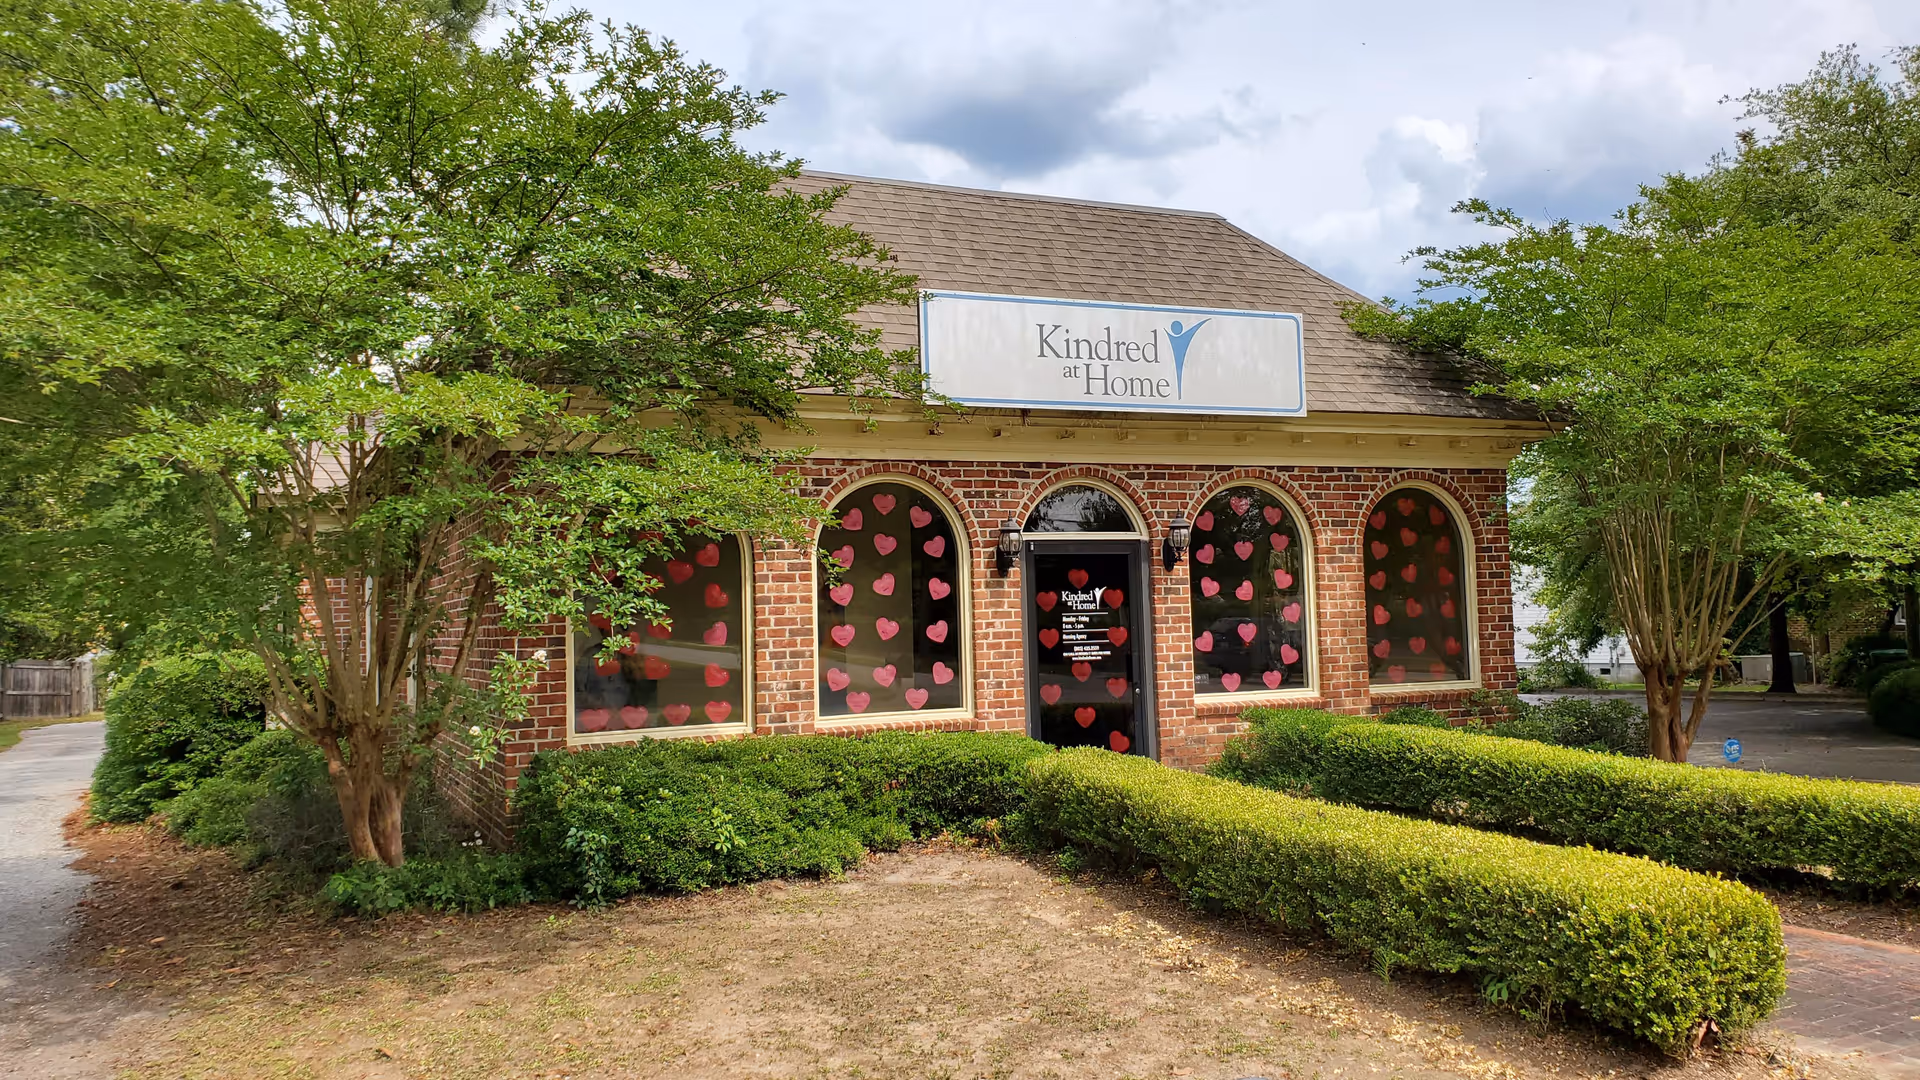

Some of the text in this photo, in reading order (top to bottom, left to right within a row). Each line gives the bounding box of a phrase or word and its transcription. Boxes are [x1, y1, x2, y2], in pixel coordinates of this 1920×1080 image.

[1035, 323, 1161, 364] Kindred
[1063, 363, 1171, 398] at Home
[1061, 590, 1093, 601] Kindred
[1072, 600, 1096, 610] Home
[1078, 615, 1090, 623] Friday
